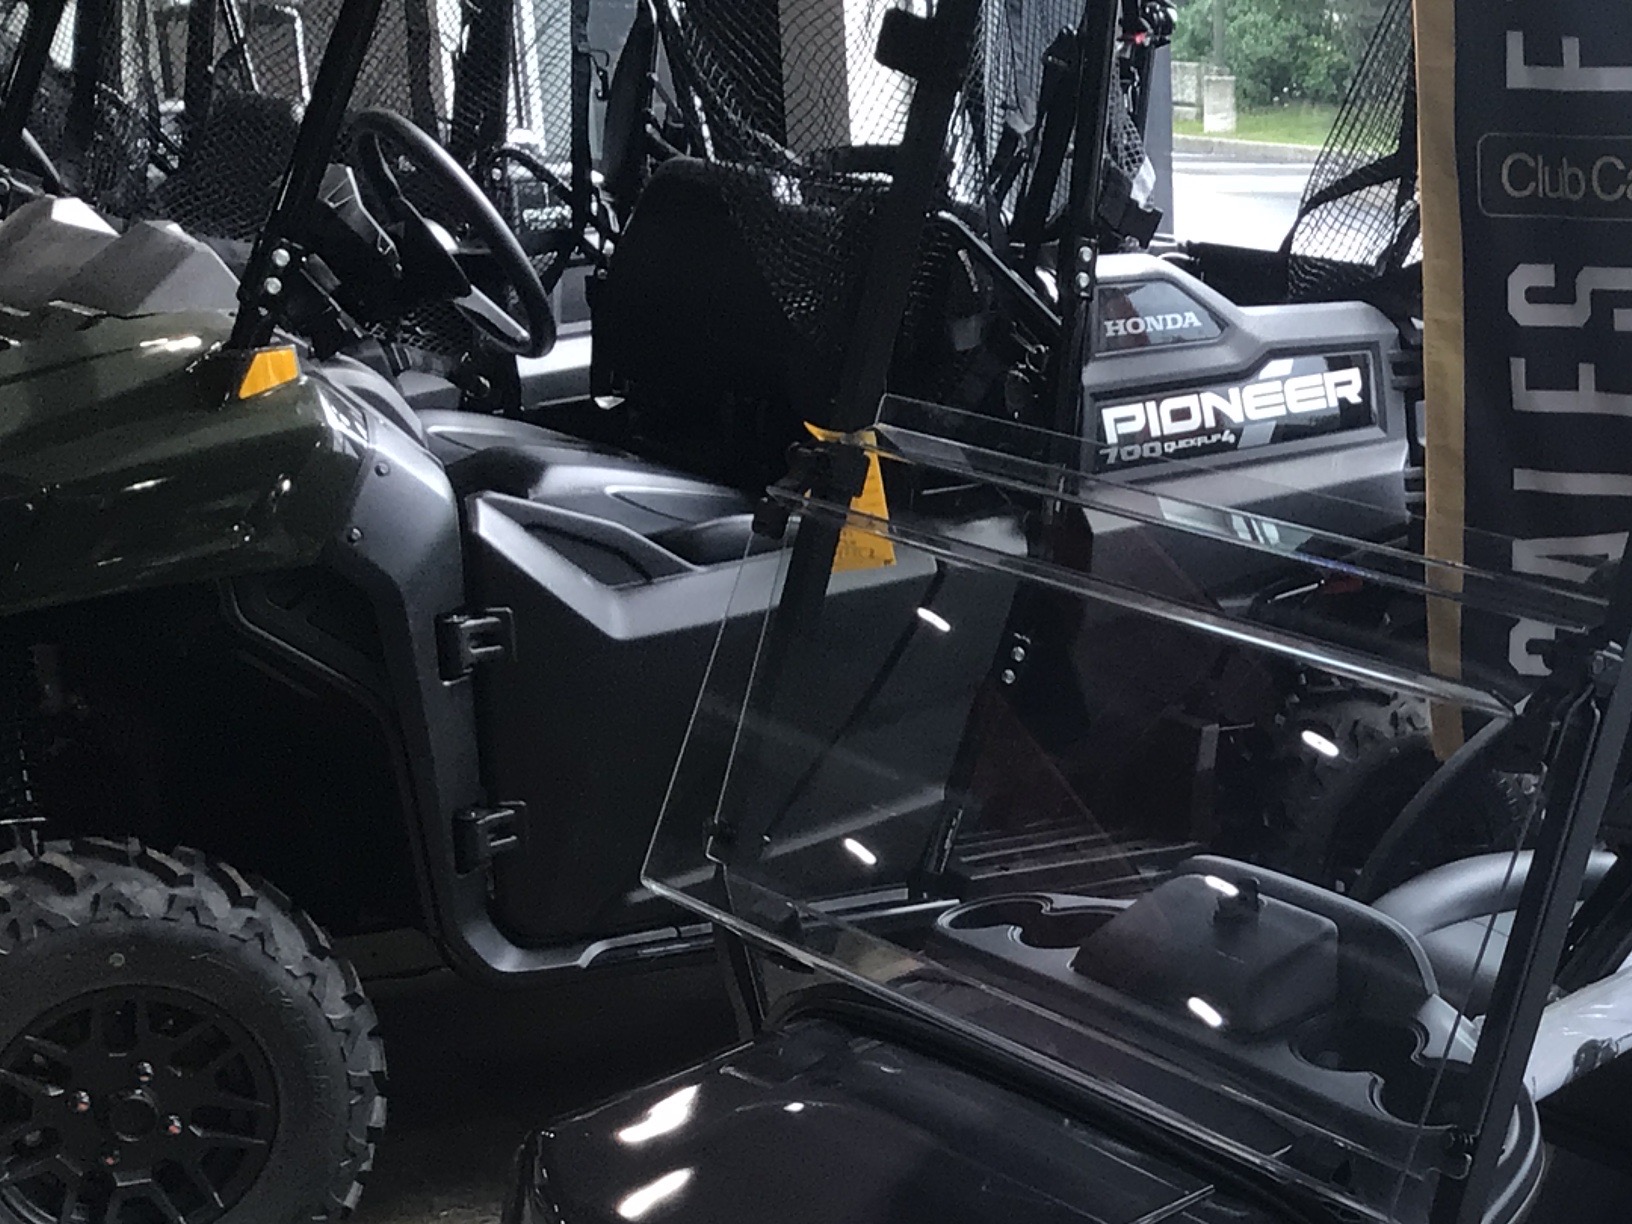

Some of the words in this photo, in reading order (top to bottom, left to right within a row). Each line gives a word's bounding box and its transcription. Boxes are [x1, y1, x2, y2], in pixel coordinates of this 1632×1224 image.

[1501, 152, 1586, 201] Club
[1104, 311, 1202, 337] HONDA
[1101, 366, 1363, 445] PIONEER
[1099, 440, 1163, 465] 700
